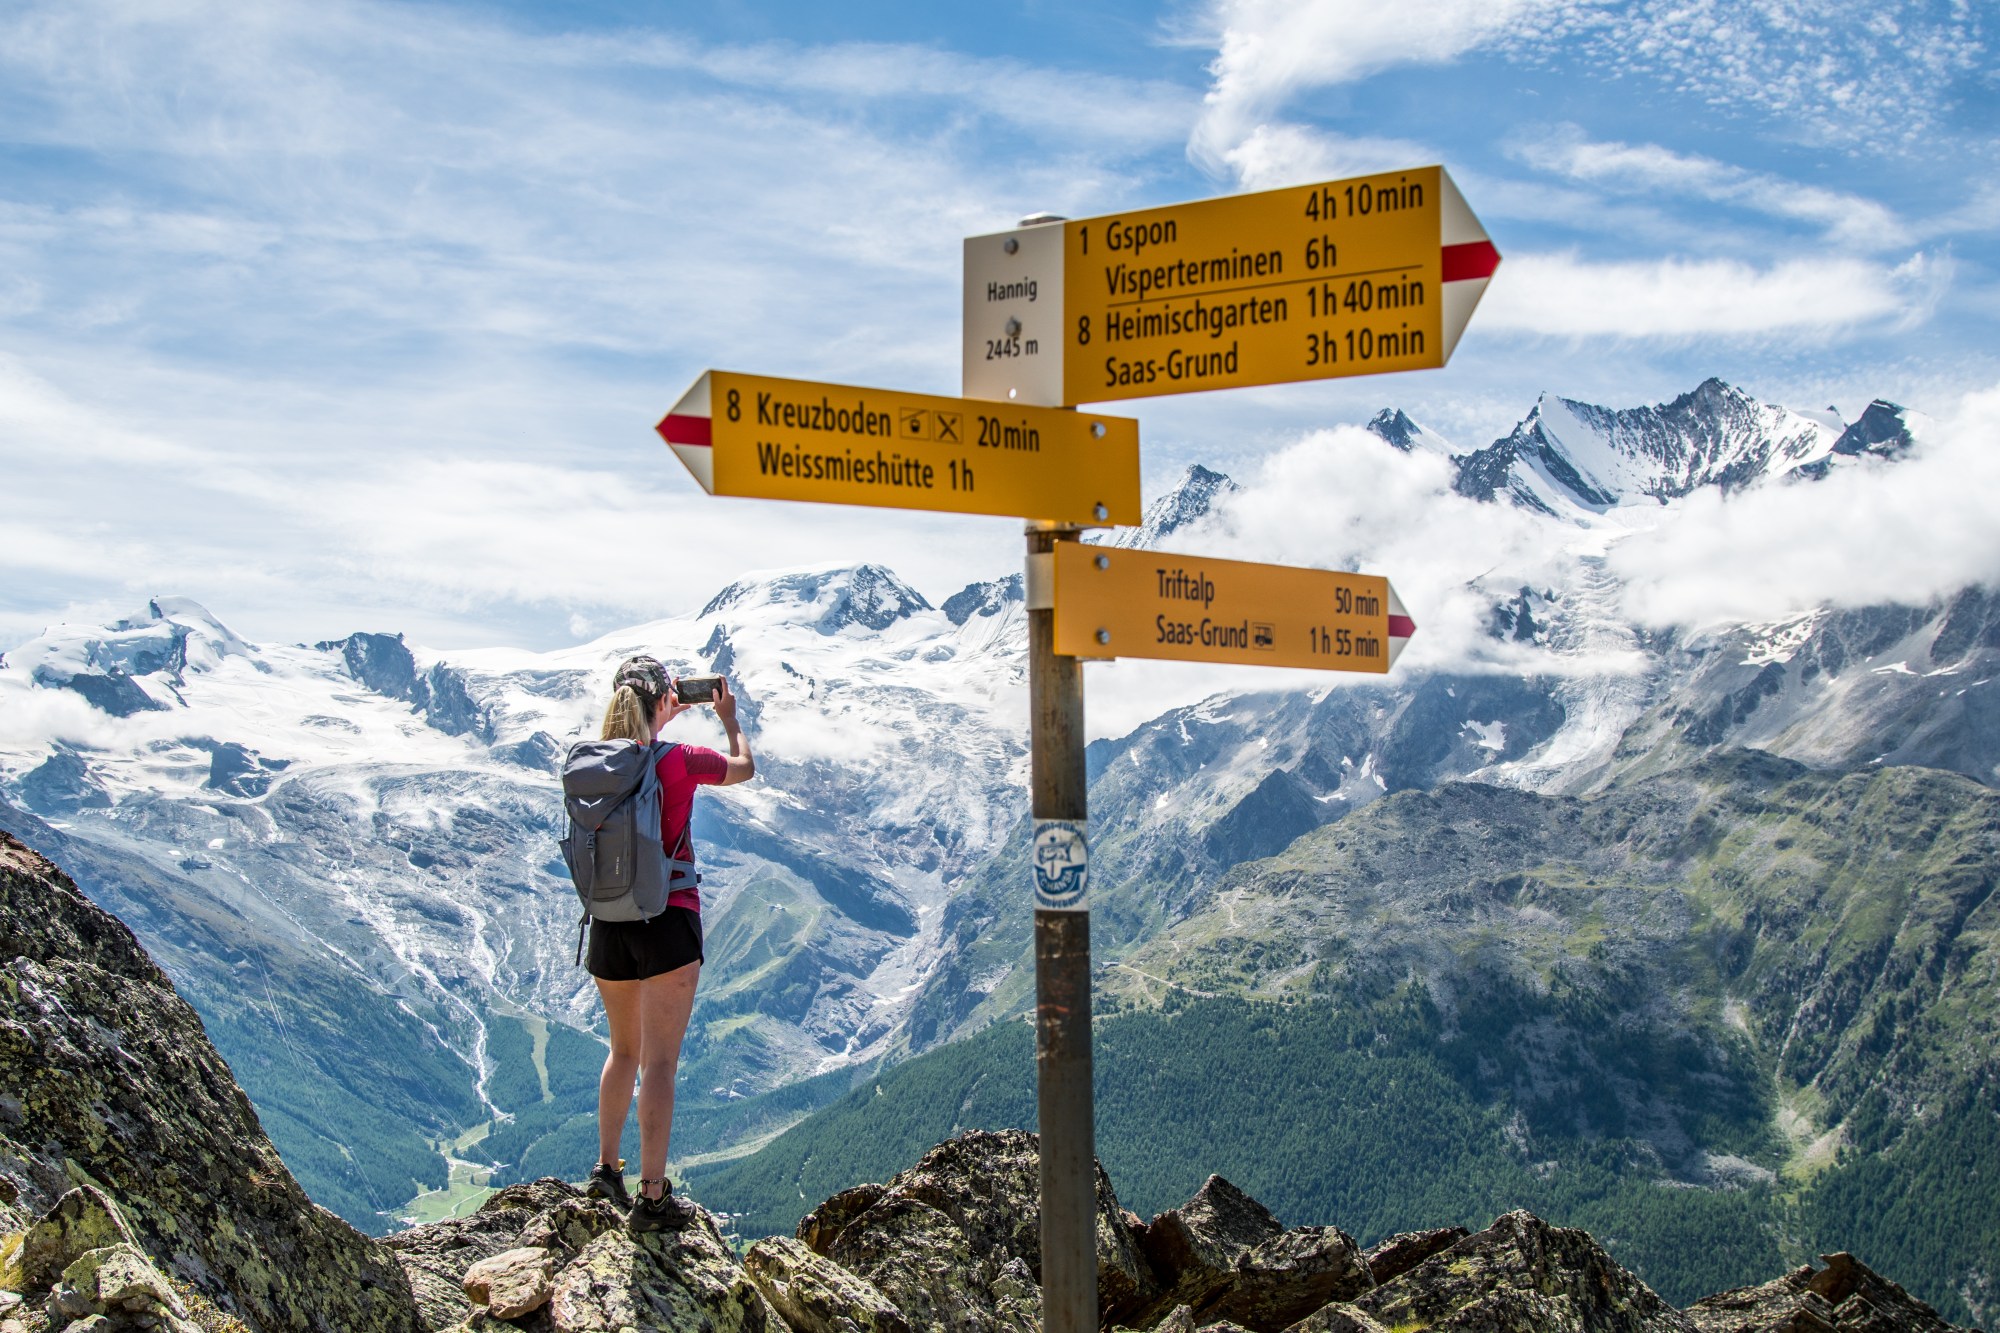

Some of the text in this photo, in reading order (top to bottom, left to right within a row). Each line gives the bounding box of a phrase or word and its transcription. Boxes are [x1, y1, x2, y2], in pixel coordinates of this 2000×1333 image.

[1080, 226, 1088, 255] 1
[1106, 219, 1177, 256] Gspon
[987, 276, 1038, 302] Hannig
[1105, 247, 1283, 300] Visperterminen
[1077, 315, 1091, 346] 8
[1105, 297, 1288, 340] Heimischgarten
[986, 337, 1039, 361] 2445 m
[1105, 342, 1238, 388] Saas-Grund
[727, 388, 741, 423] 8
[757, 392, 891, 437] Kreuzboden
[757, 442, 934, 489] Weissmieshütte
[1156, 568, 1379, 617] Triftalp 50 min
[1156, 613, 1248, 649] Saas-Grund
[1336, 628, 1352, 656] 55
[1355, 630, 1379, 657] min
